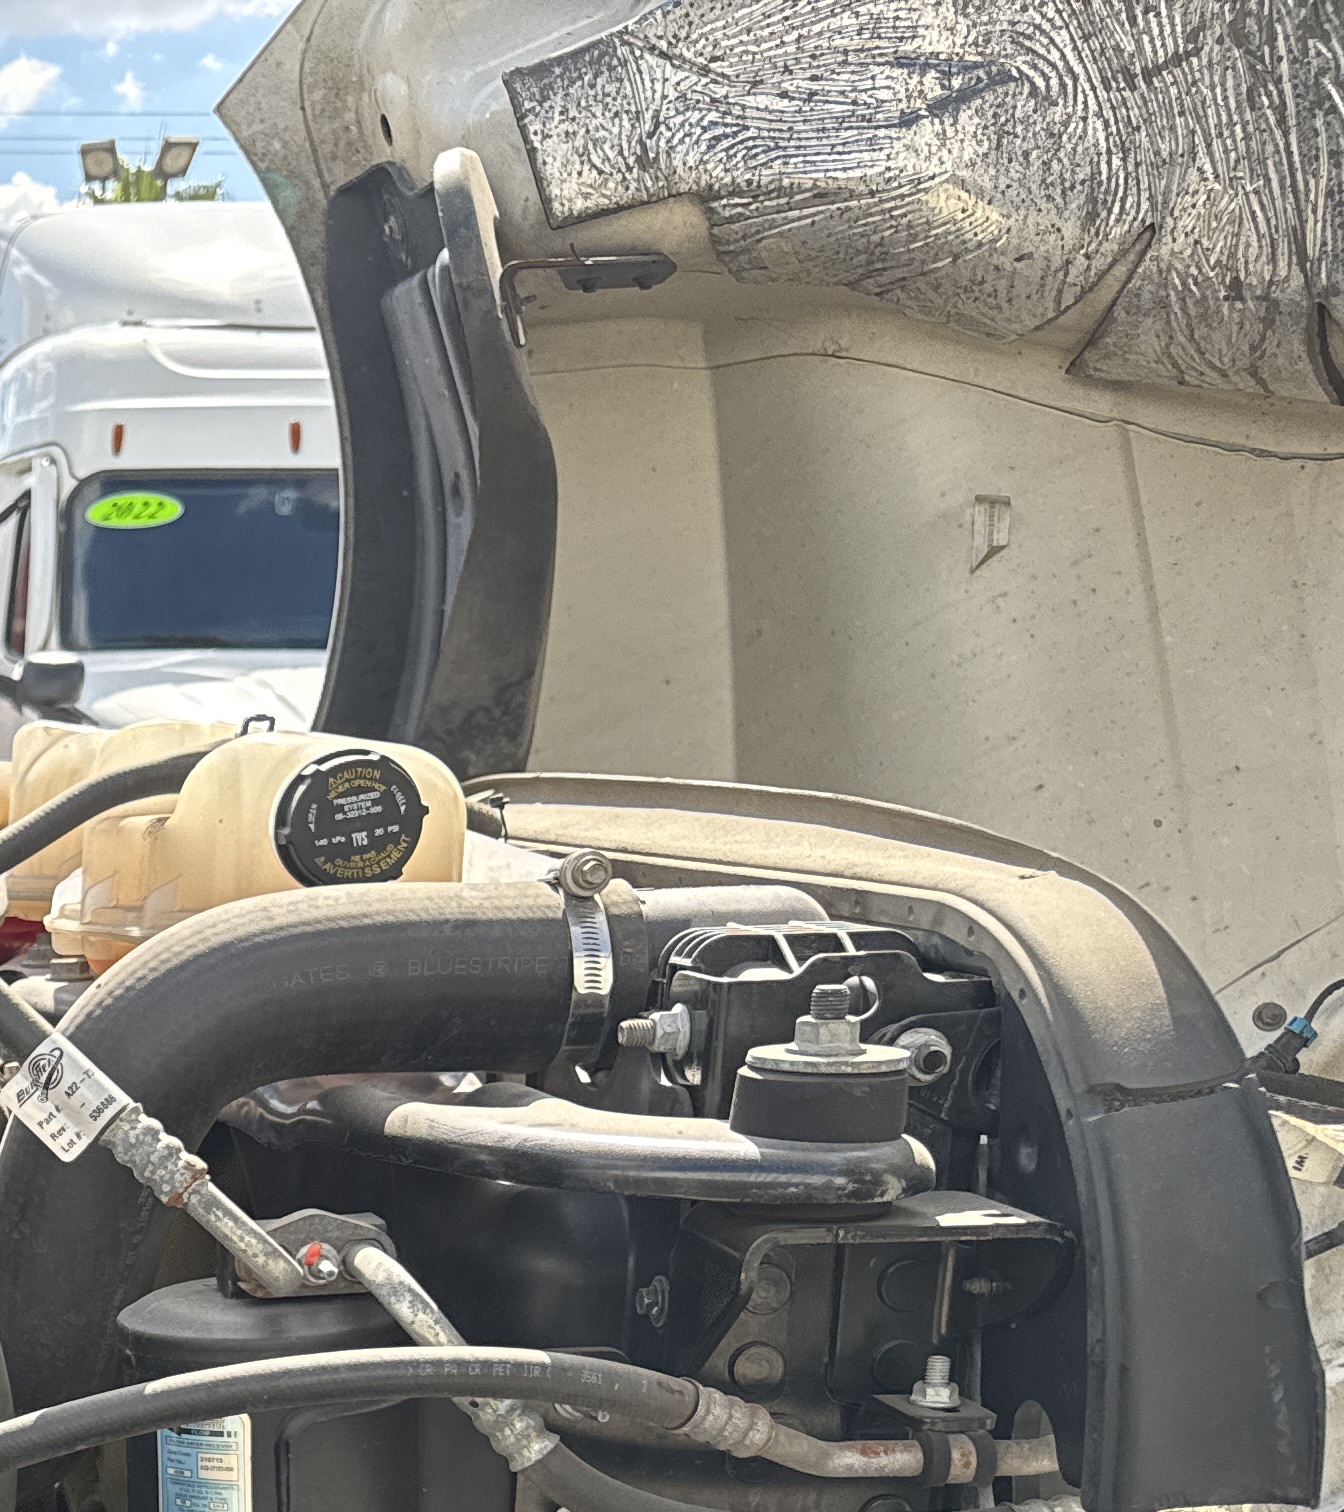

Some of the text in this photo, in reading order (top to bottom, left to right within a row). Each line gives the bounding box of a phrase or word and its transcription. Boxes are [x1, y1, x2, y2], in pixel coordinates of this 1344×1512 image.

[337, 768, 381, 781] CAUTION
[351, 830, 368, 847] TVS
[374, 828, 384, 836] 20
[36, 1111, 57, 1130] Part
[60, 1138, 77, 1154] Lot
